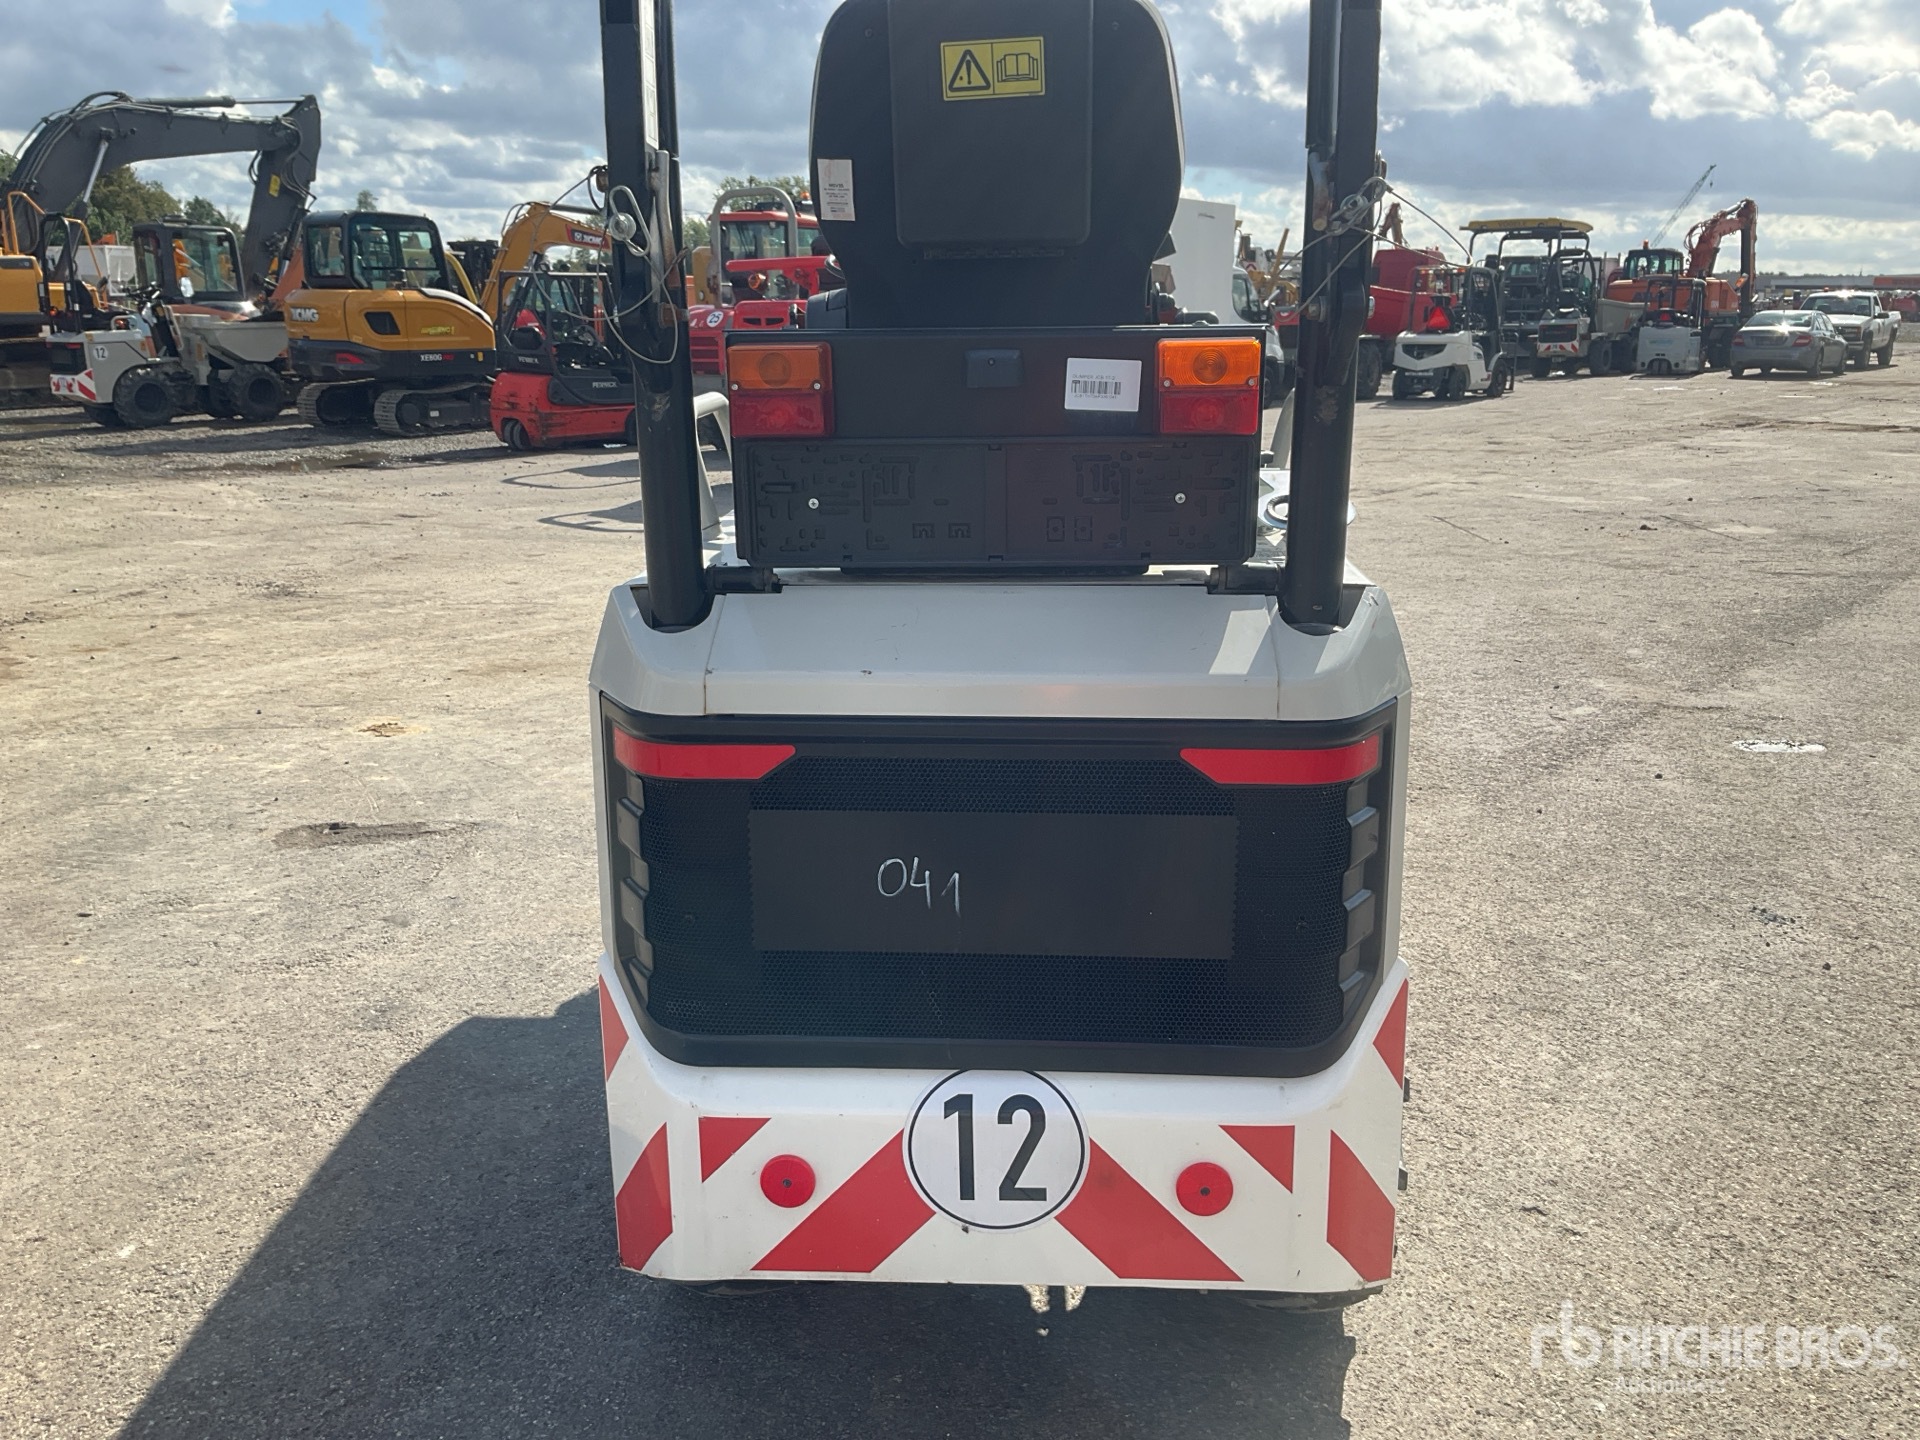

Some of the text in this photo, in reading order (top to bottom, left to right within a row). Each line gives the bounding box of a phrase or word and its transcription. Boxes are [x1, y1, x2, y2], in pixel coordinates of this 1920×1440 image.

[290, 308, 319, 322] XCMG
[708, 313, 722, 324] 25
[95, 347, 107, 359] 12
[878, 857, 960, 917] 041
[943, 1093, 1048, 1202] 12
